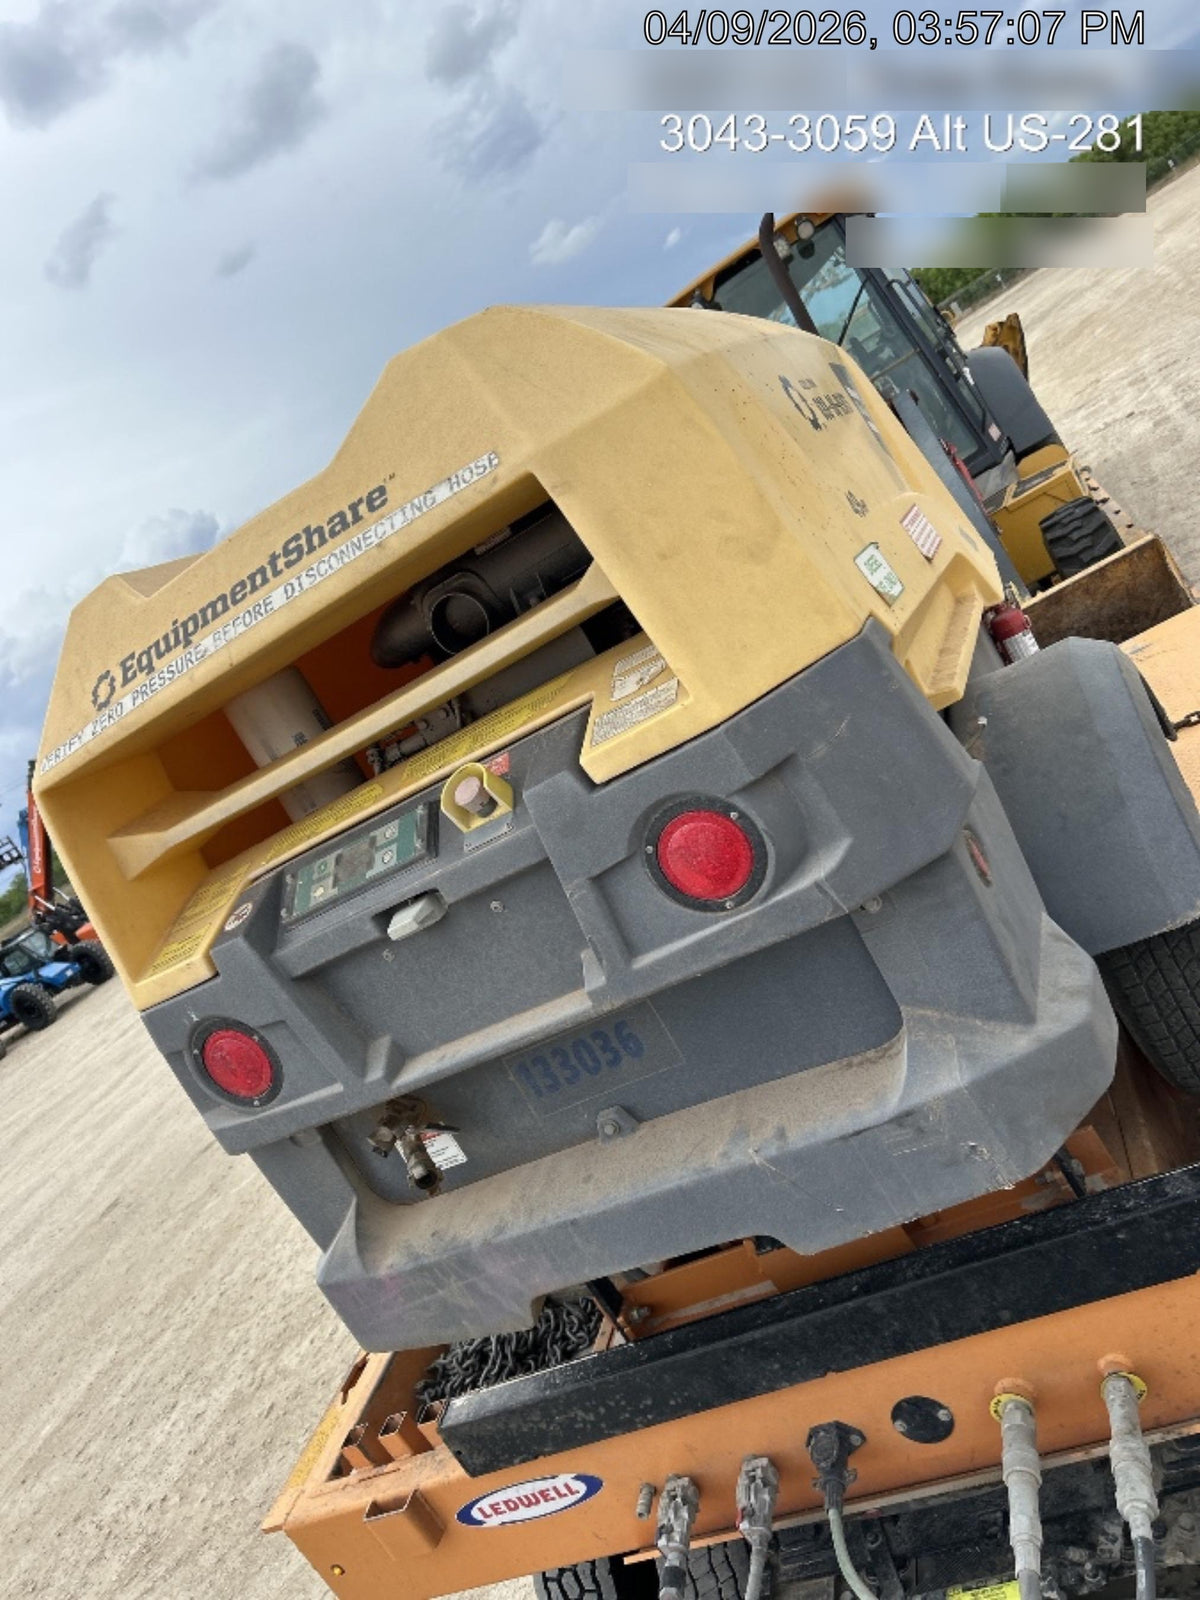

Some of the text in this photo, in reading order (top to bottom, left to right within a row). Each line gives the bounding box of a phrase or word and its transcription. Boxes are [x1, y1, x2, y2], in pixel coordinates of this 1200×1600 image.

[92, 703, 123, 735] ZERO
[213, 595, 274, 647] BEFORE
[283, 490, 437, 600] DISCONNECTING
[120, 483, 389, 689] EquipmentShare
[514, 1019, 645, 1097] 133036
[477, 1482, 580, 1520] LEDWELL
